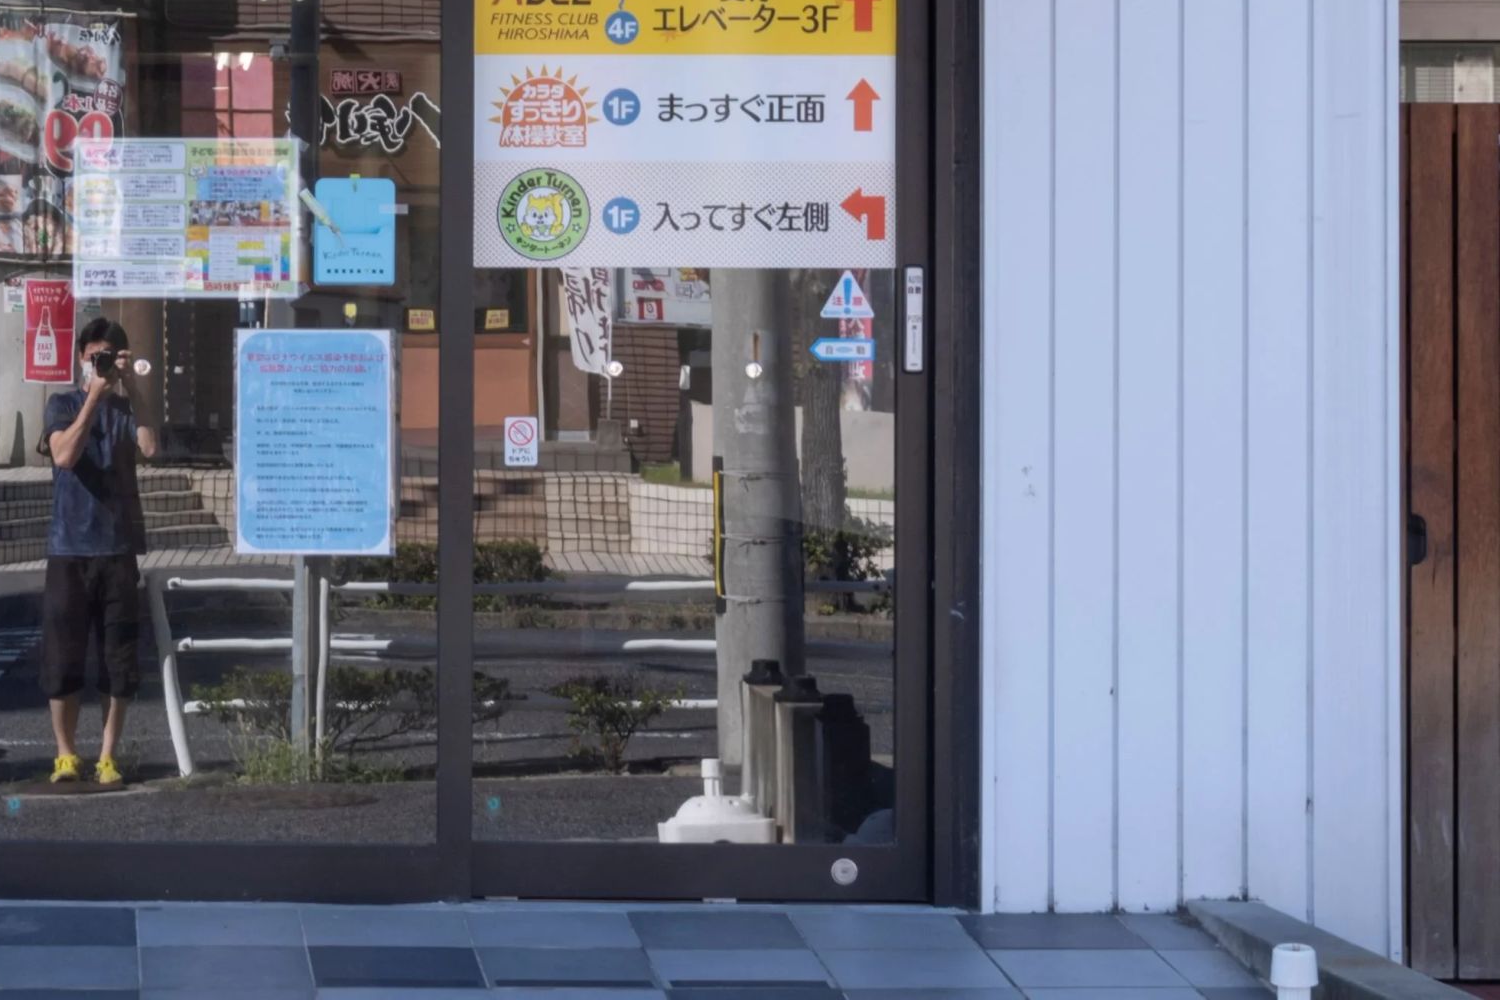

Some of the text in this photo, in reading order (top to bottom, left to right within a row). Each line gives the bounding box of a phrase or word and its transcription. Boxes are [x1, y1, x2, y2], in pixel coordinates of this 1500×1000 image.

[490, 12, 599, 26] FITNESS CLUB
[608, 18, 637, 39] 4F
[652, 4, 841, 34] エレベーター3F
[497, 27, 591, 41] HIROSHIMA
[522, 84, 565, 99] カラダ
[507, 99, 582, 123] すっきり
[607, 96, 635, 120] 1F
[657, 93, 827, 124] まっすぐ正面
[500, 124, 587, 147] 体操教室
[501, 172, 582, 218] Kinder Turnen
[607, 205, 635, 229] 1F
[652, 201, 830, 233] 入ってすぐ左側
[515, 235, 572, 254] キンダートーネン
